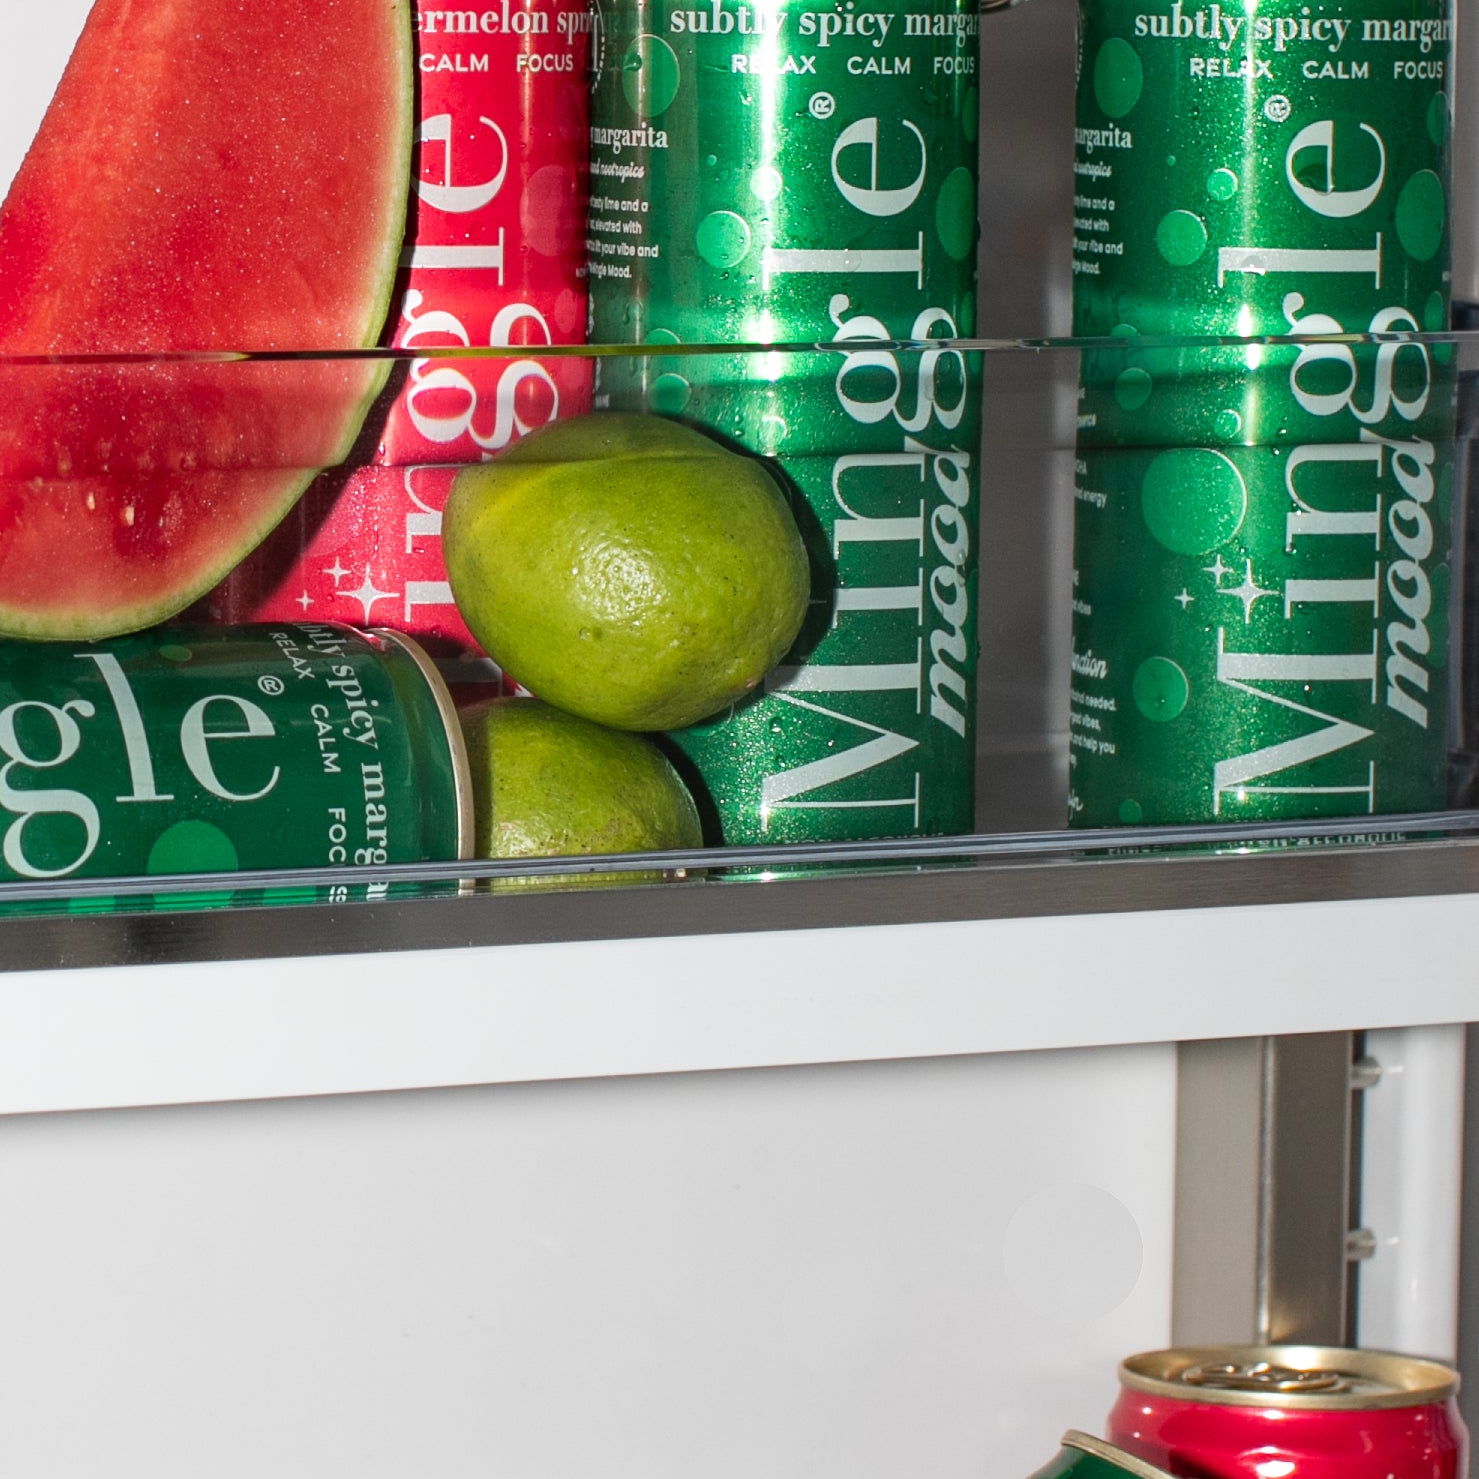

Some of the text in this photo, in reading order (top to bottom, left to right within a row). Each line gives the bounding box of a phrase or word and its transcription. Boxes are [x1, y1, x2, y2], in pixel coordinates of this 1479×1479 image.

[798, 0, 895, 48] spicy
[1133, 4, 1353, 52] subtly spicy
[418, 52, 575, 73] CALM FOCUS
[730, 54, 976, 75] REAX CALM FOCUS
[1189, 57, 1445, 80] RELAX CALM FOCUS
[593, 121, 669, 155] margarita
[620, 198, 640, 212] and
[640, 201, 649, 212] a
[622, 219, 643, 235] with
[616, 241, 659, 258] vibe and
[904, 435, 971, 739] mood
[1359, 427, 1436, 730] mood
[268, 631, 342, 774] RELAX CALM
[325, 663, 381, 751] spicy
